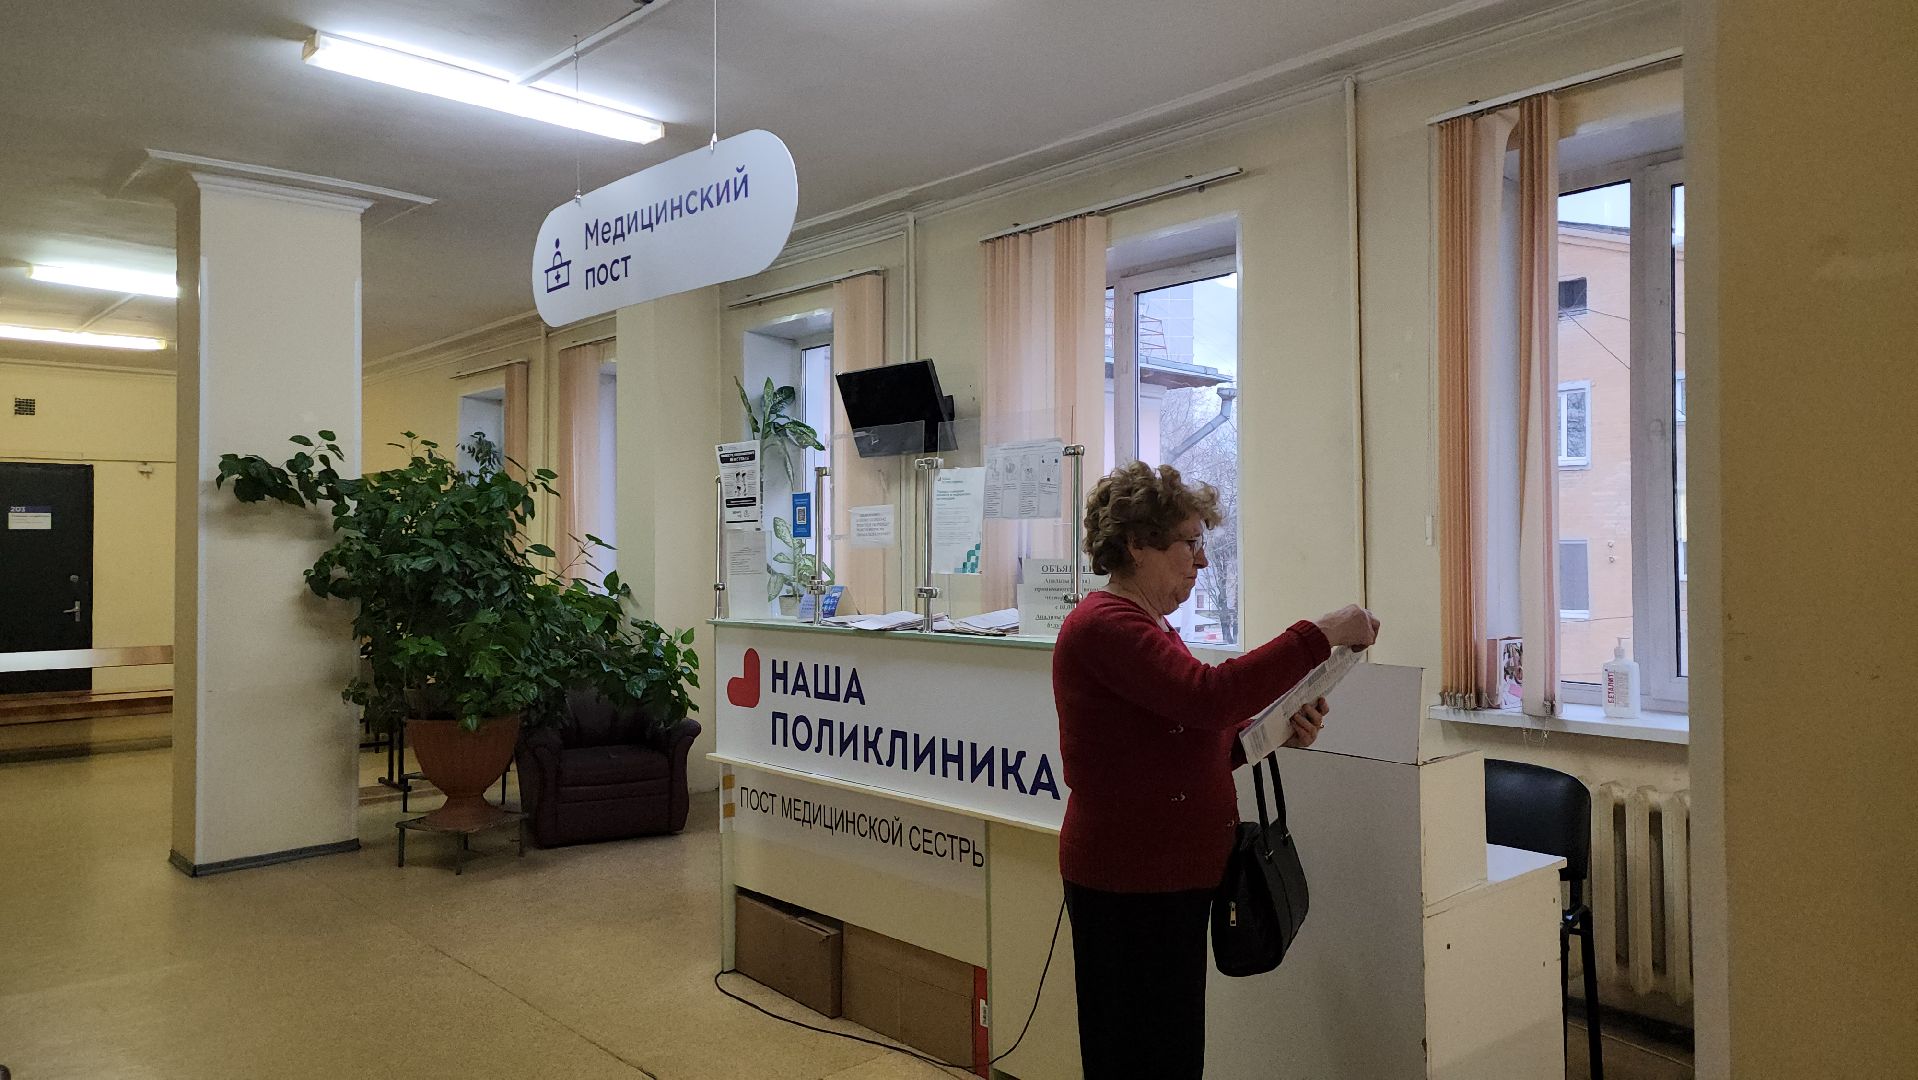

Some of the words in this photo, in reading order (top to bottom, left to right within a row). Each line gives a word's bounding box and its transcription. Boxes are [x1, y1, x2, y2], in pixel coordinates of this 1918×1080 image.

[585, 164, 749, 250] Медицинский
[585, 255, 631, 291] пост
[771, 659, 866, 706] НАША
[771, 711, 1061, 801] ПОЛИКЛИНИКА
[740, 786, 777, 815] ПОСТ
[781, 798, 902, 847] МЕДИЦИНСКОЙ
